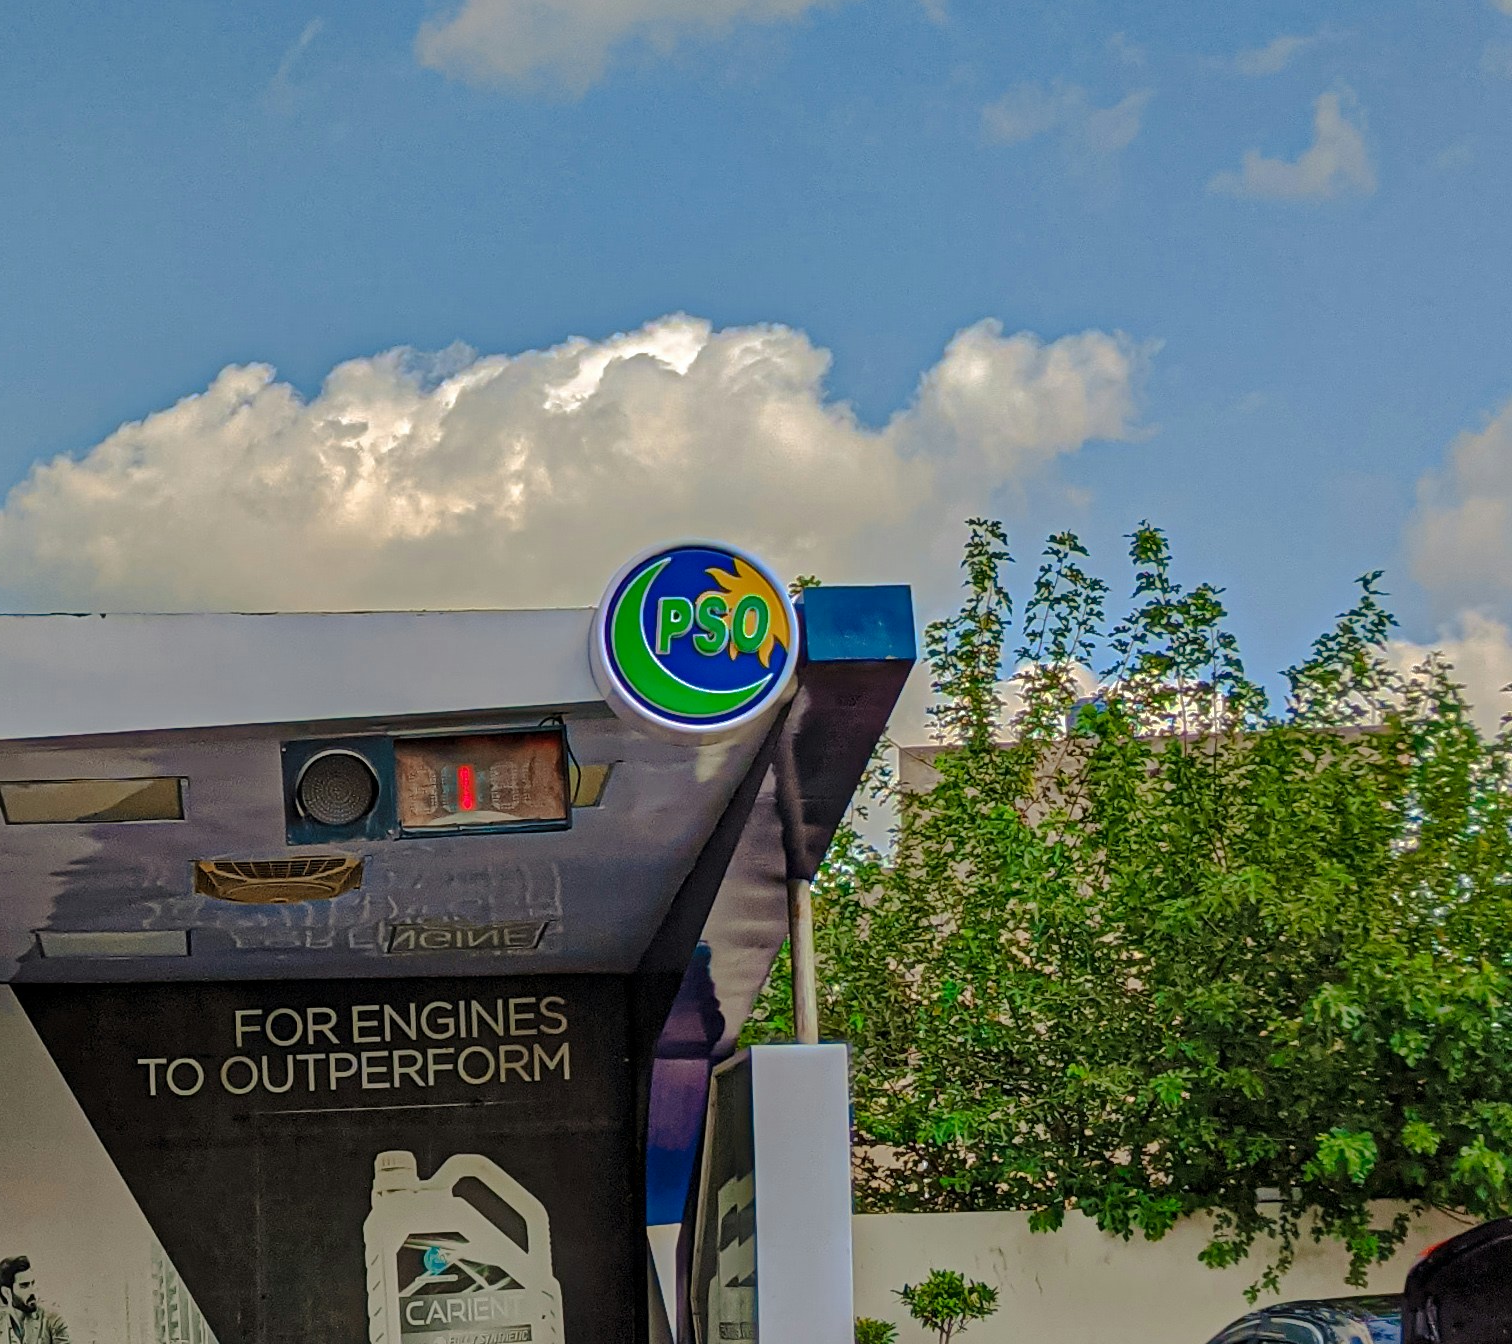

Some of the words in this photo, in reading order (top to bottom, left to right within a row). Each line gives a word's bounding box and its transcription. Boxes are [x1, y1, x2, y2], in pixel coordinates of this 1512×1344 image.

[655, 594, 771, 656] PSO
[235, 1006, 340, 1047] FOR
[352, 996, 568, 1044] ENGINES
[137, 1057, 204, 1096] TO
[220, 1043, 570, 1094] OUTPERFORM
[405, 1296, 523, 1326] CARIENT
